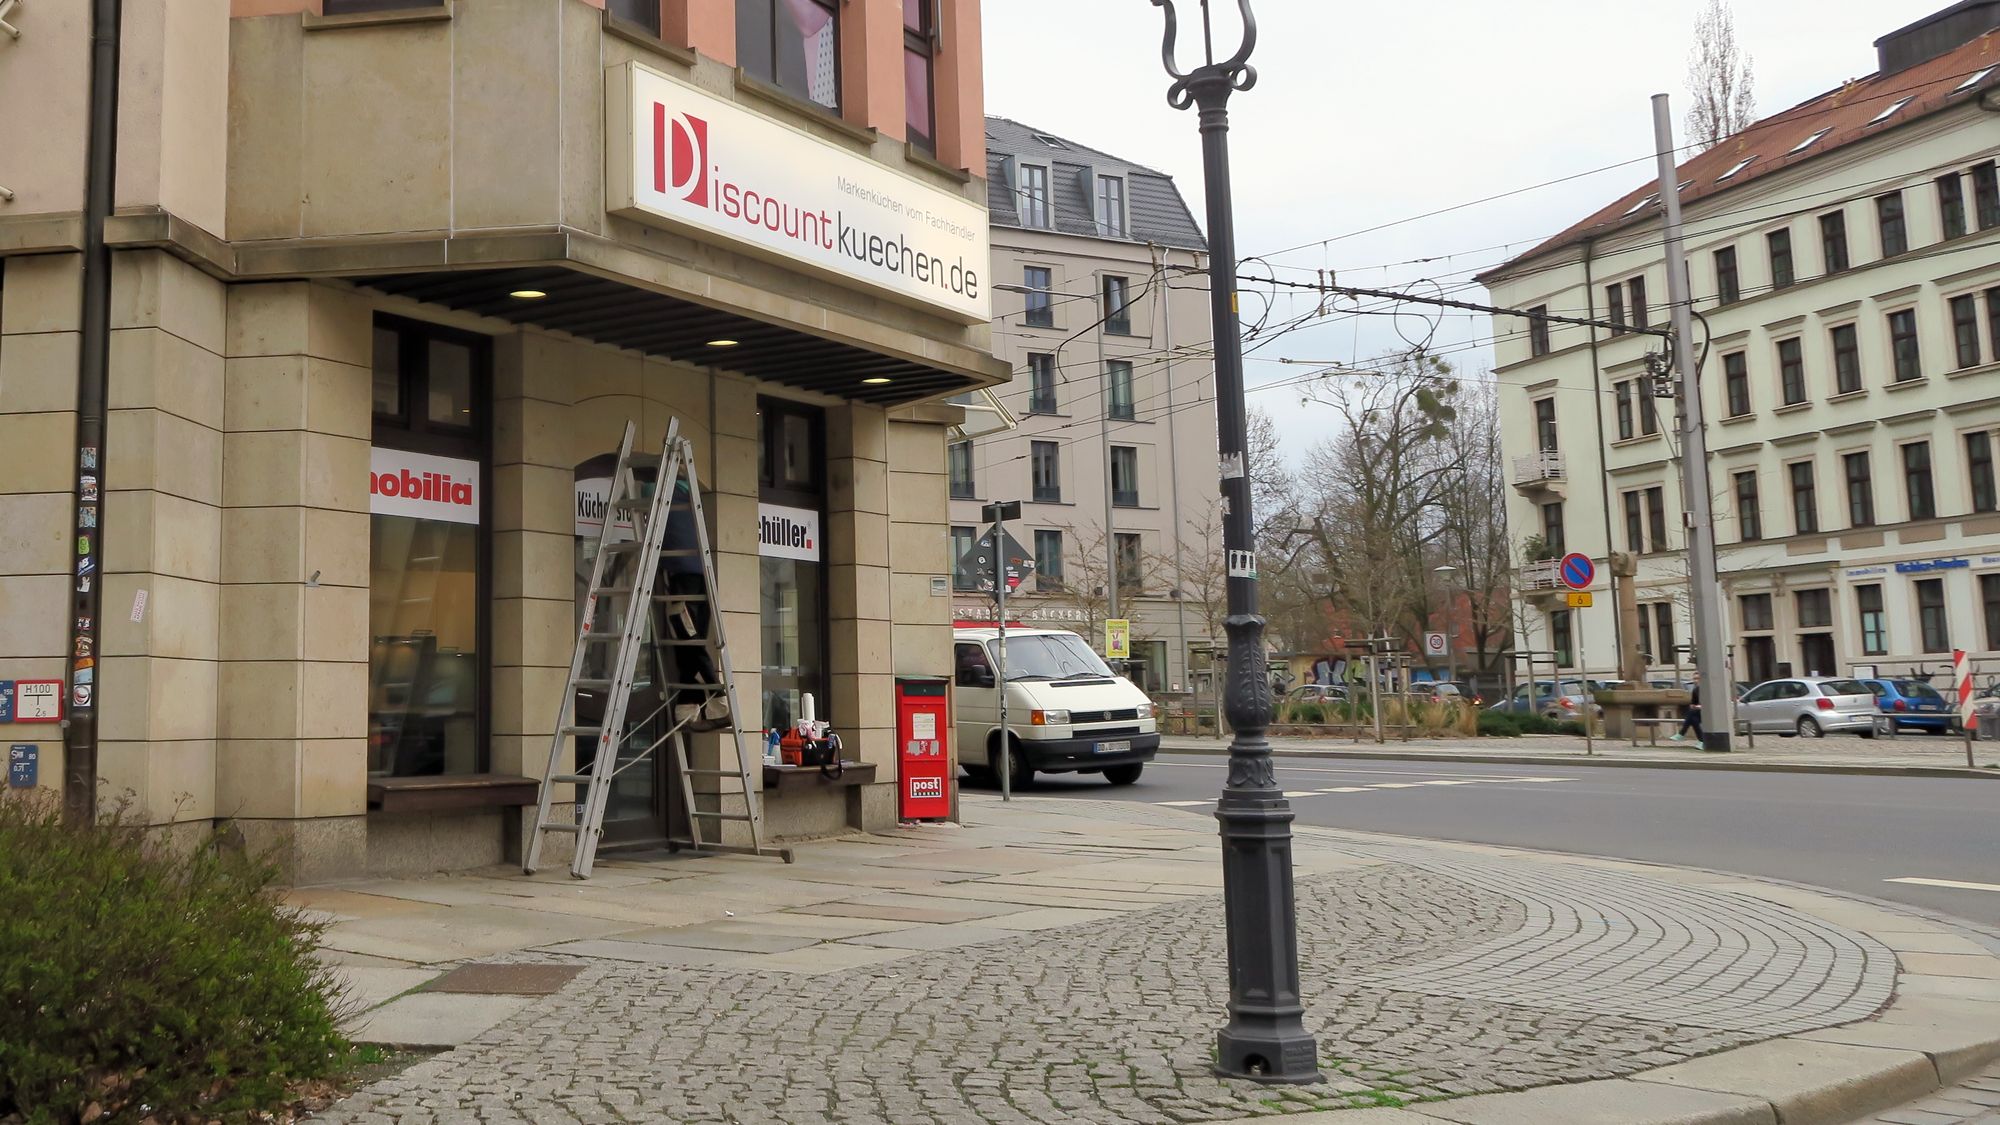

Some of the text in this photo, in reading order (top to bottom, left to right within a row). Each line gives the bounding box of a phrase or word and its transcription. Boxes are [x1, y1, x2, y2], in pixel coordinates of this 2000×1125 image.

[837, 175, 976, 243] Markenküchen vom Fachhändler
[913, 777, 939, 792] post
